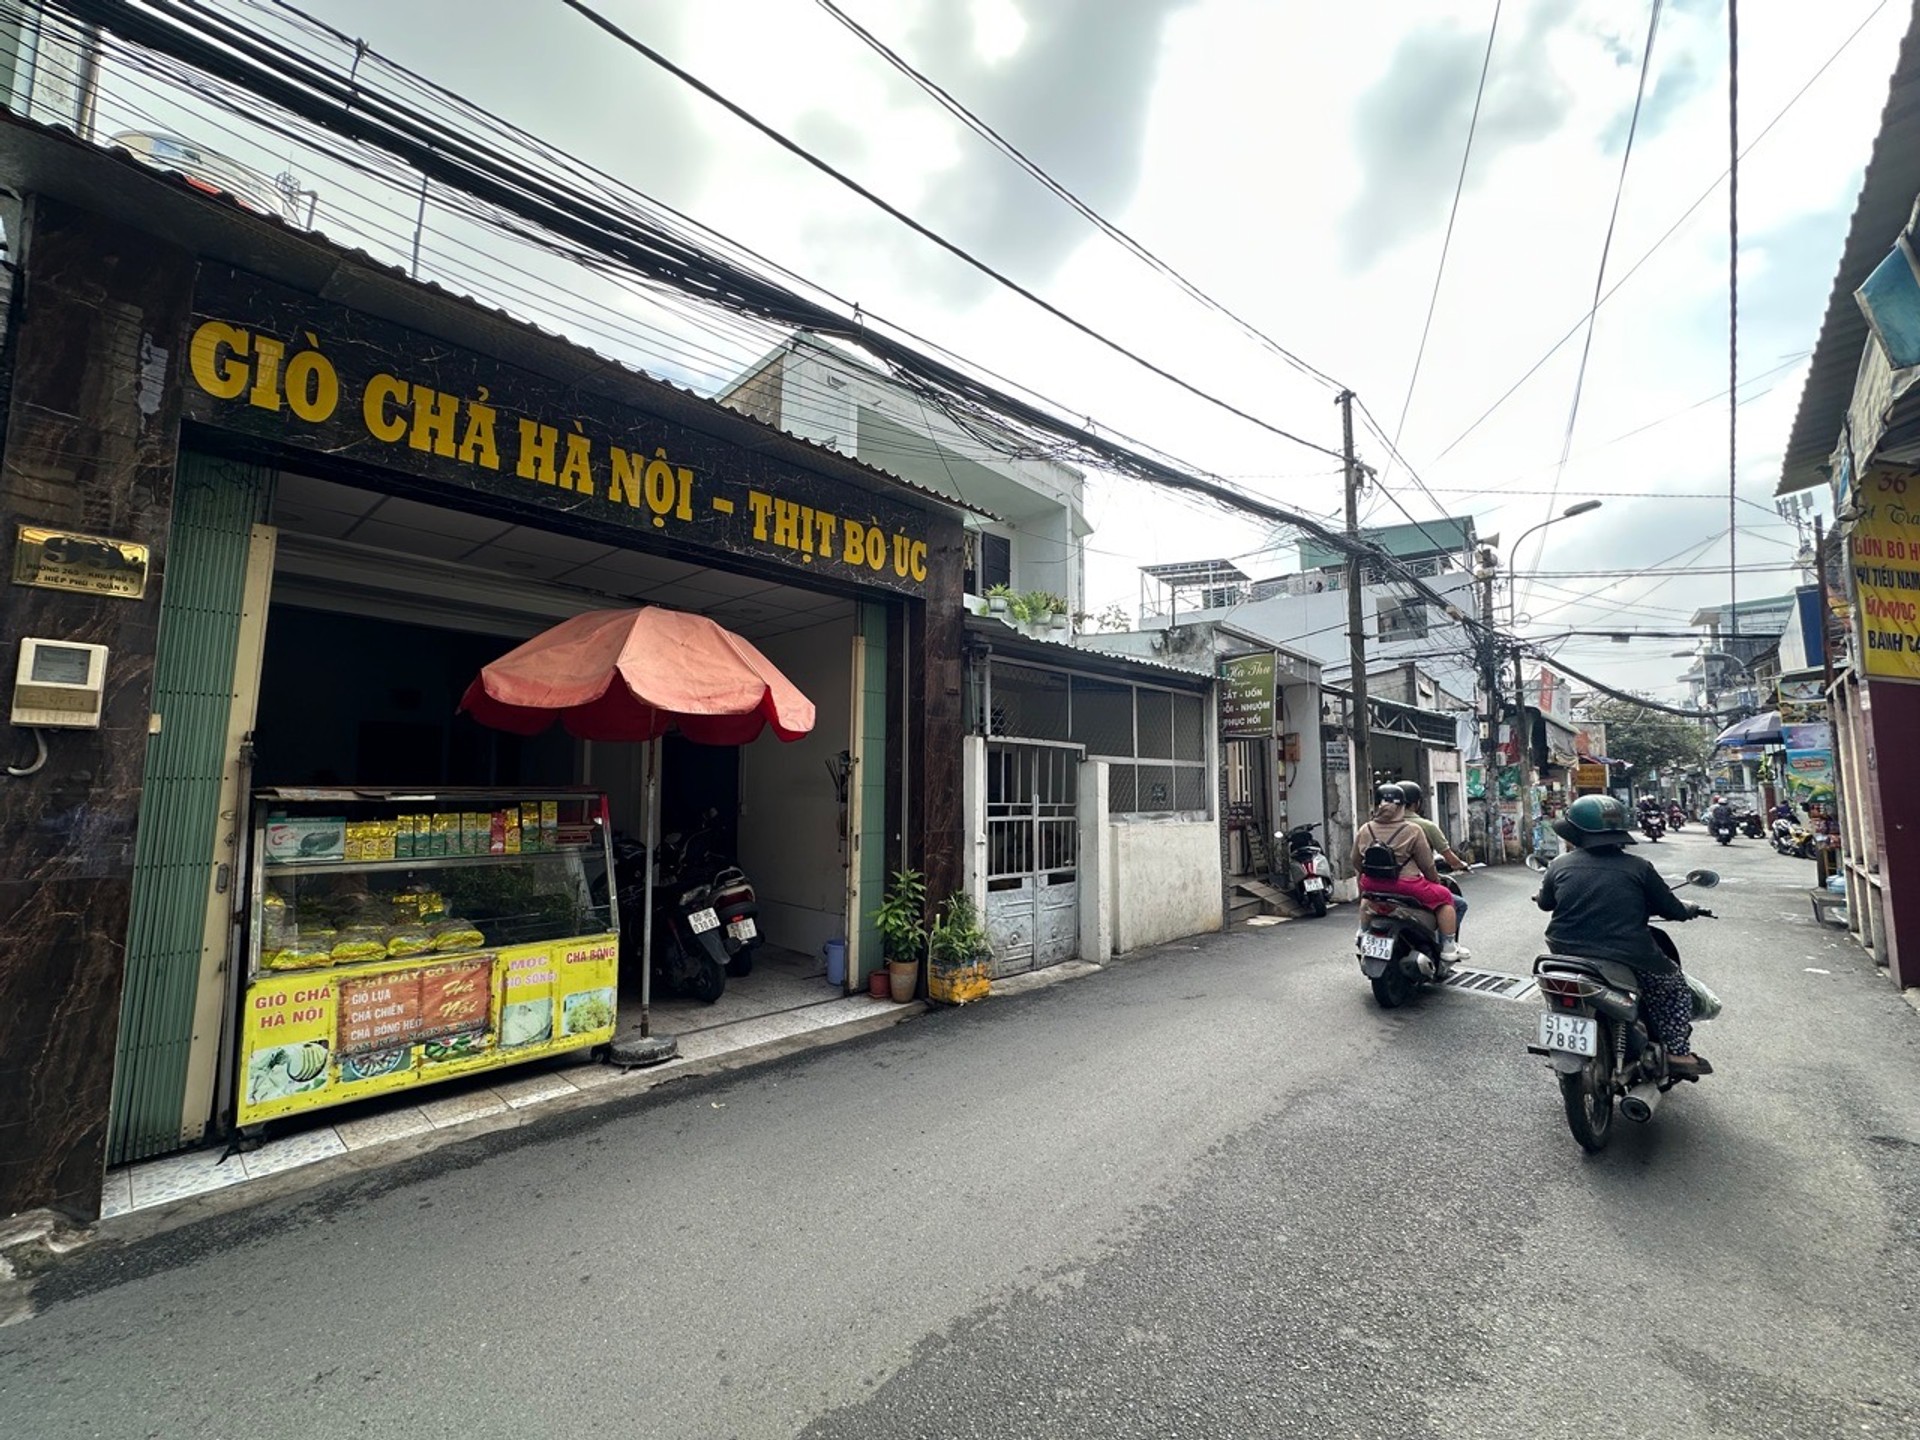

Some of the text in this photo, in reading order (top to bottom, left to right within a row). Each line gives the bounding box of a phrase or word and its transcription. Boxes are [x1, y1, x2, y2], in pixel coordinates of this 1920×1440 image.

[189, 321, 339, 423] GIÒ
[363, 373, 499, 470] CHẢ
[516, 417, 594, 496] HÀ
[609, 445, 694, 528] NỘI
[749, 490, 836, 563] THỊT
[843, 515, 886, 571] BÒ
[893, 526, 928, 583] ÚC
[1878, 471, 1906, 494] 36
[1887, 536, 1905, 559] BÒ
[255, 992, 287, 1009] GIÒ
[261, 1007, 323, 1028] HÀ NỘI
[1546, 1030, 1588, 1052] 7883
